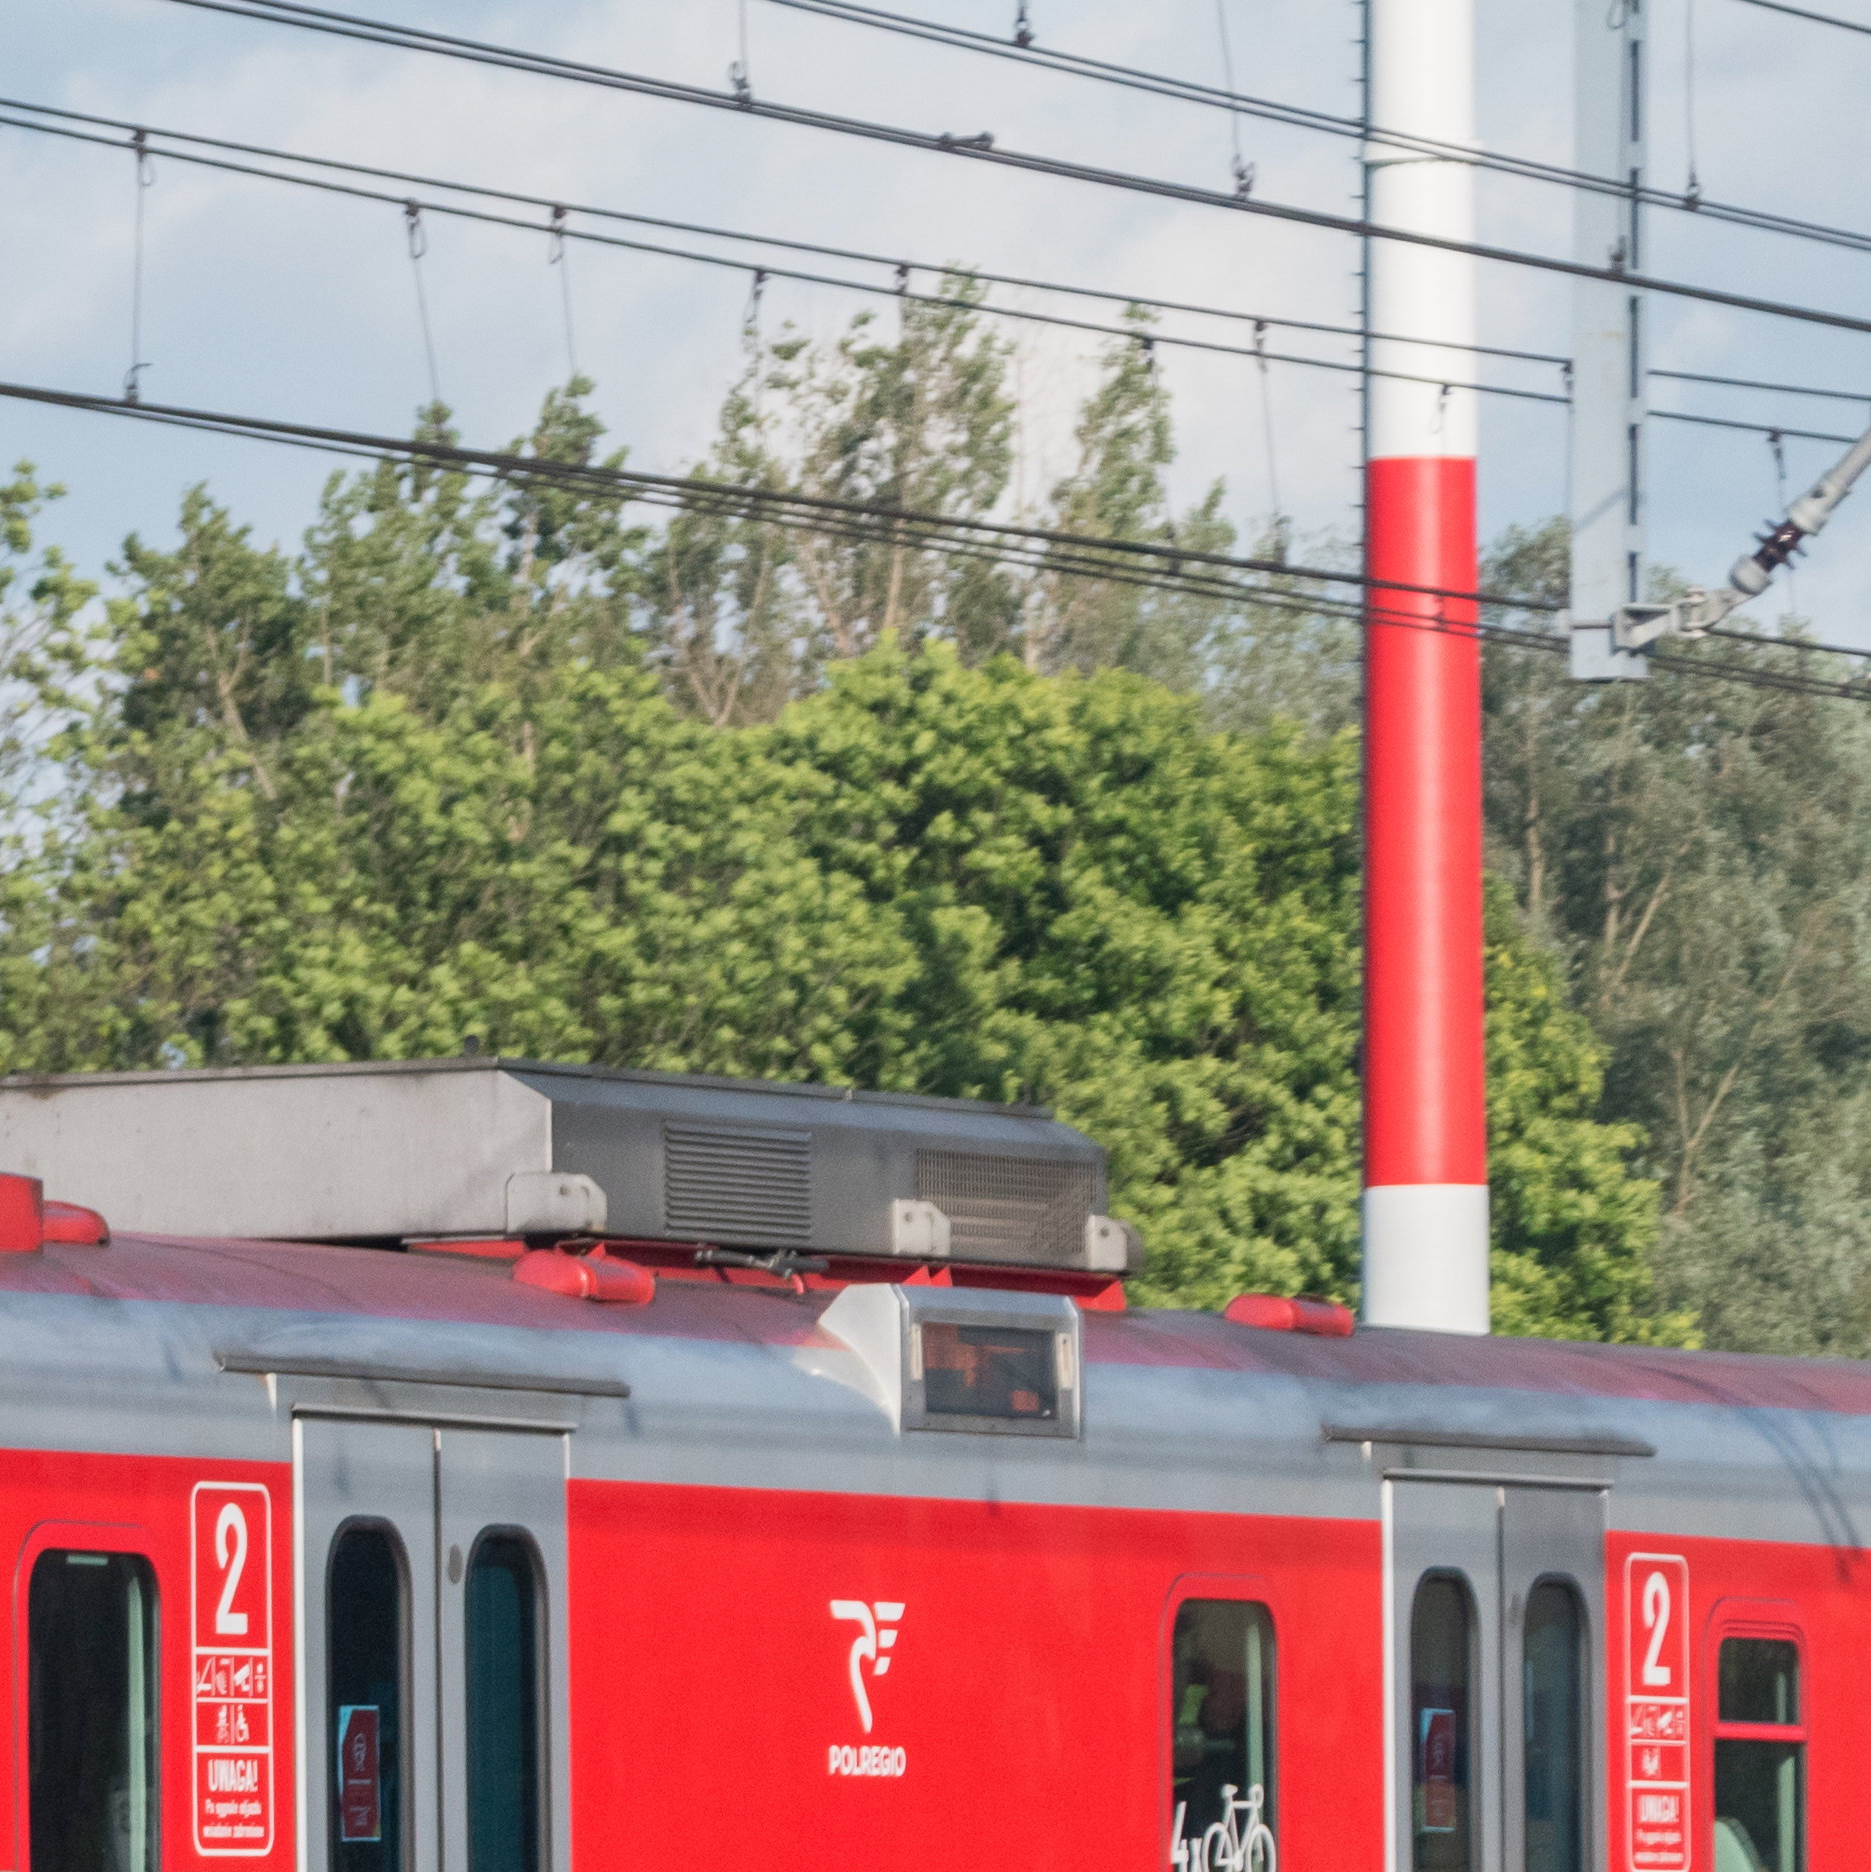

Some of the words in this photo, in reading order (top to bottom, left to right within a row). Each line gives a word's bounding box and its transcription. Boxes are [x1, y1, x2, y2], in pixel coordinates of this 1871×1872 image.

[215, 1503, 248, 1635] 2
[1643, 1571, 1671, 1687] 2
[829, 1745, 907, 1777] POLREGIO
